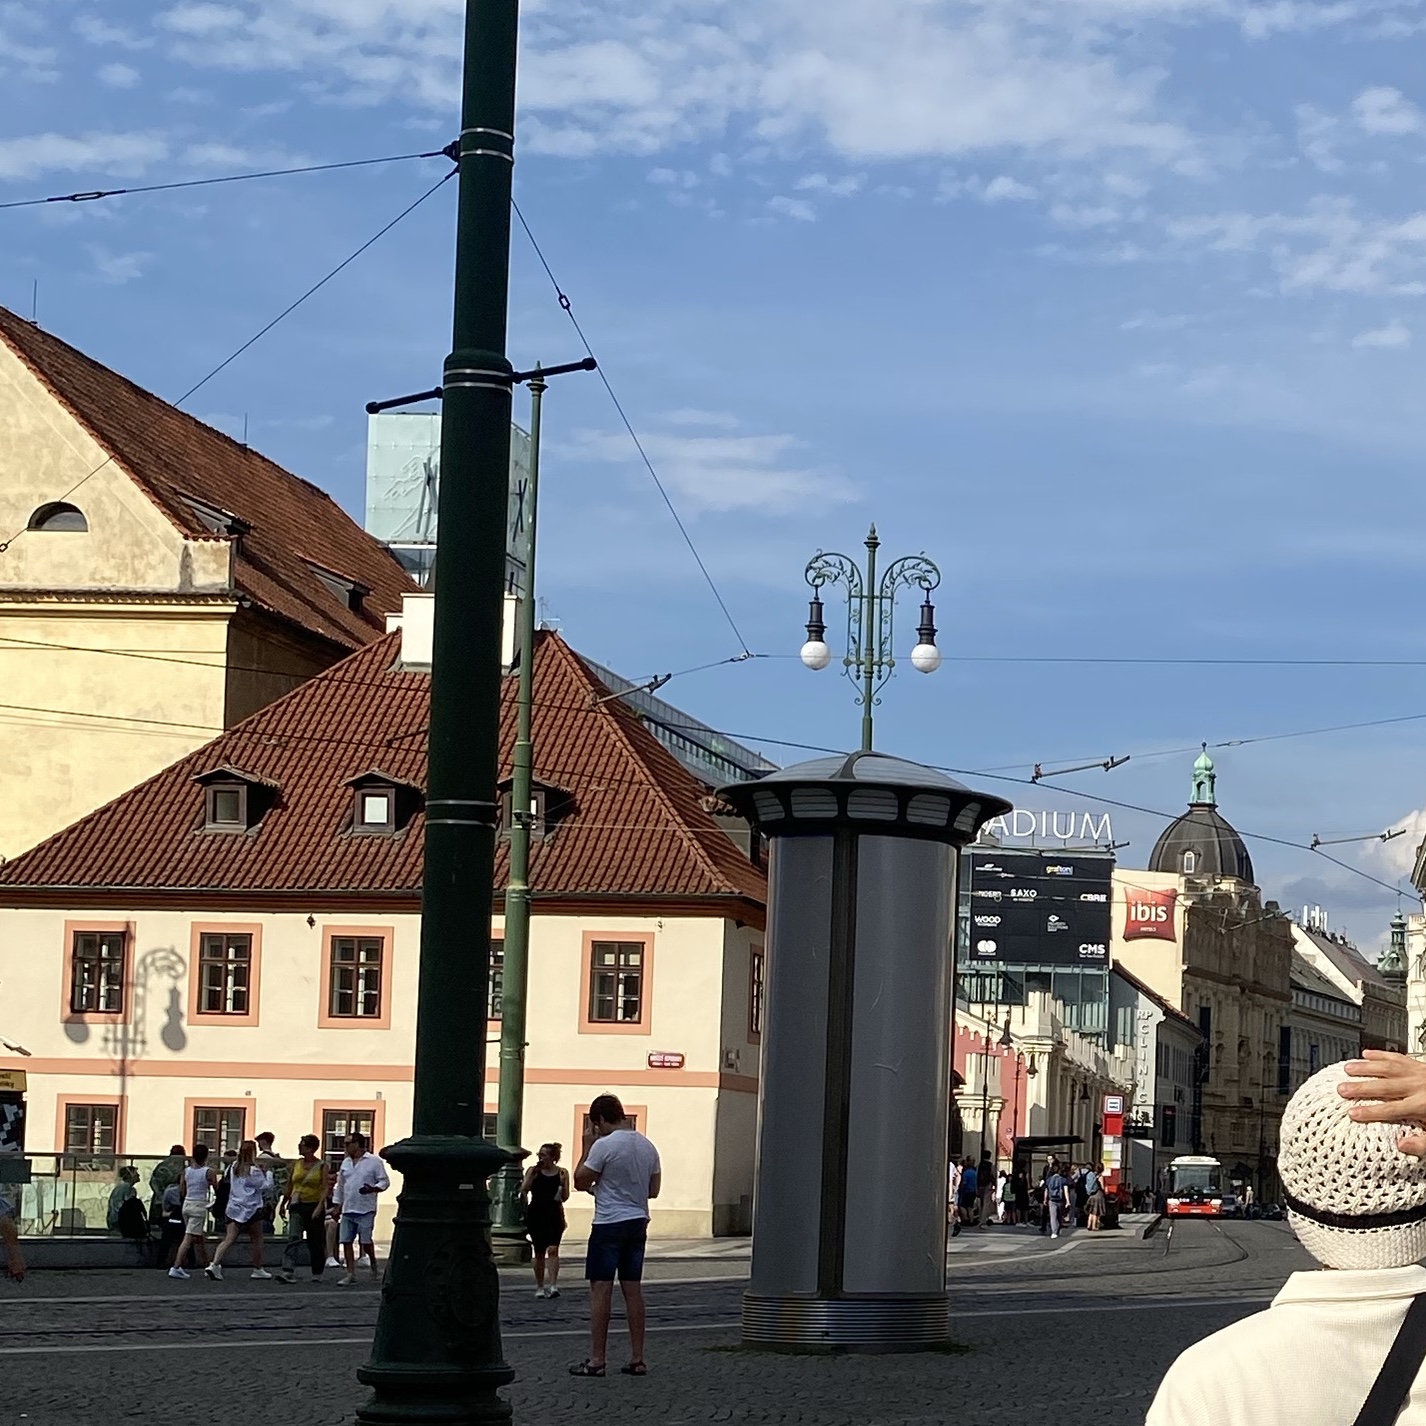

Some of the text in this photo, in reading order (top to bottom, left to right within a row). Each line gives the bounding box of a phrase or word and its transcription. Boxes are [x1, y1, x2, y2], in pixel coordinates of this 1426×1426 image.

[984, 809, 1112, 841] ADIUM
[1010, 888, 1037, 898] SAXO
[1131, 901, 1167, 922] ibis
[1079, 944, 1105, 954] CMS
[1137, 1010, 1153, 1020] RP
[1139, 1025, 1150, 1104] CLINIC
